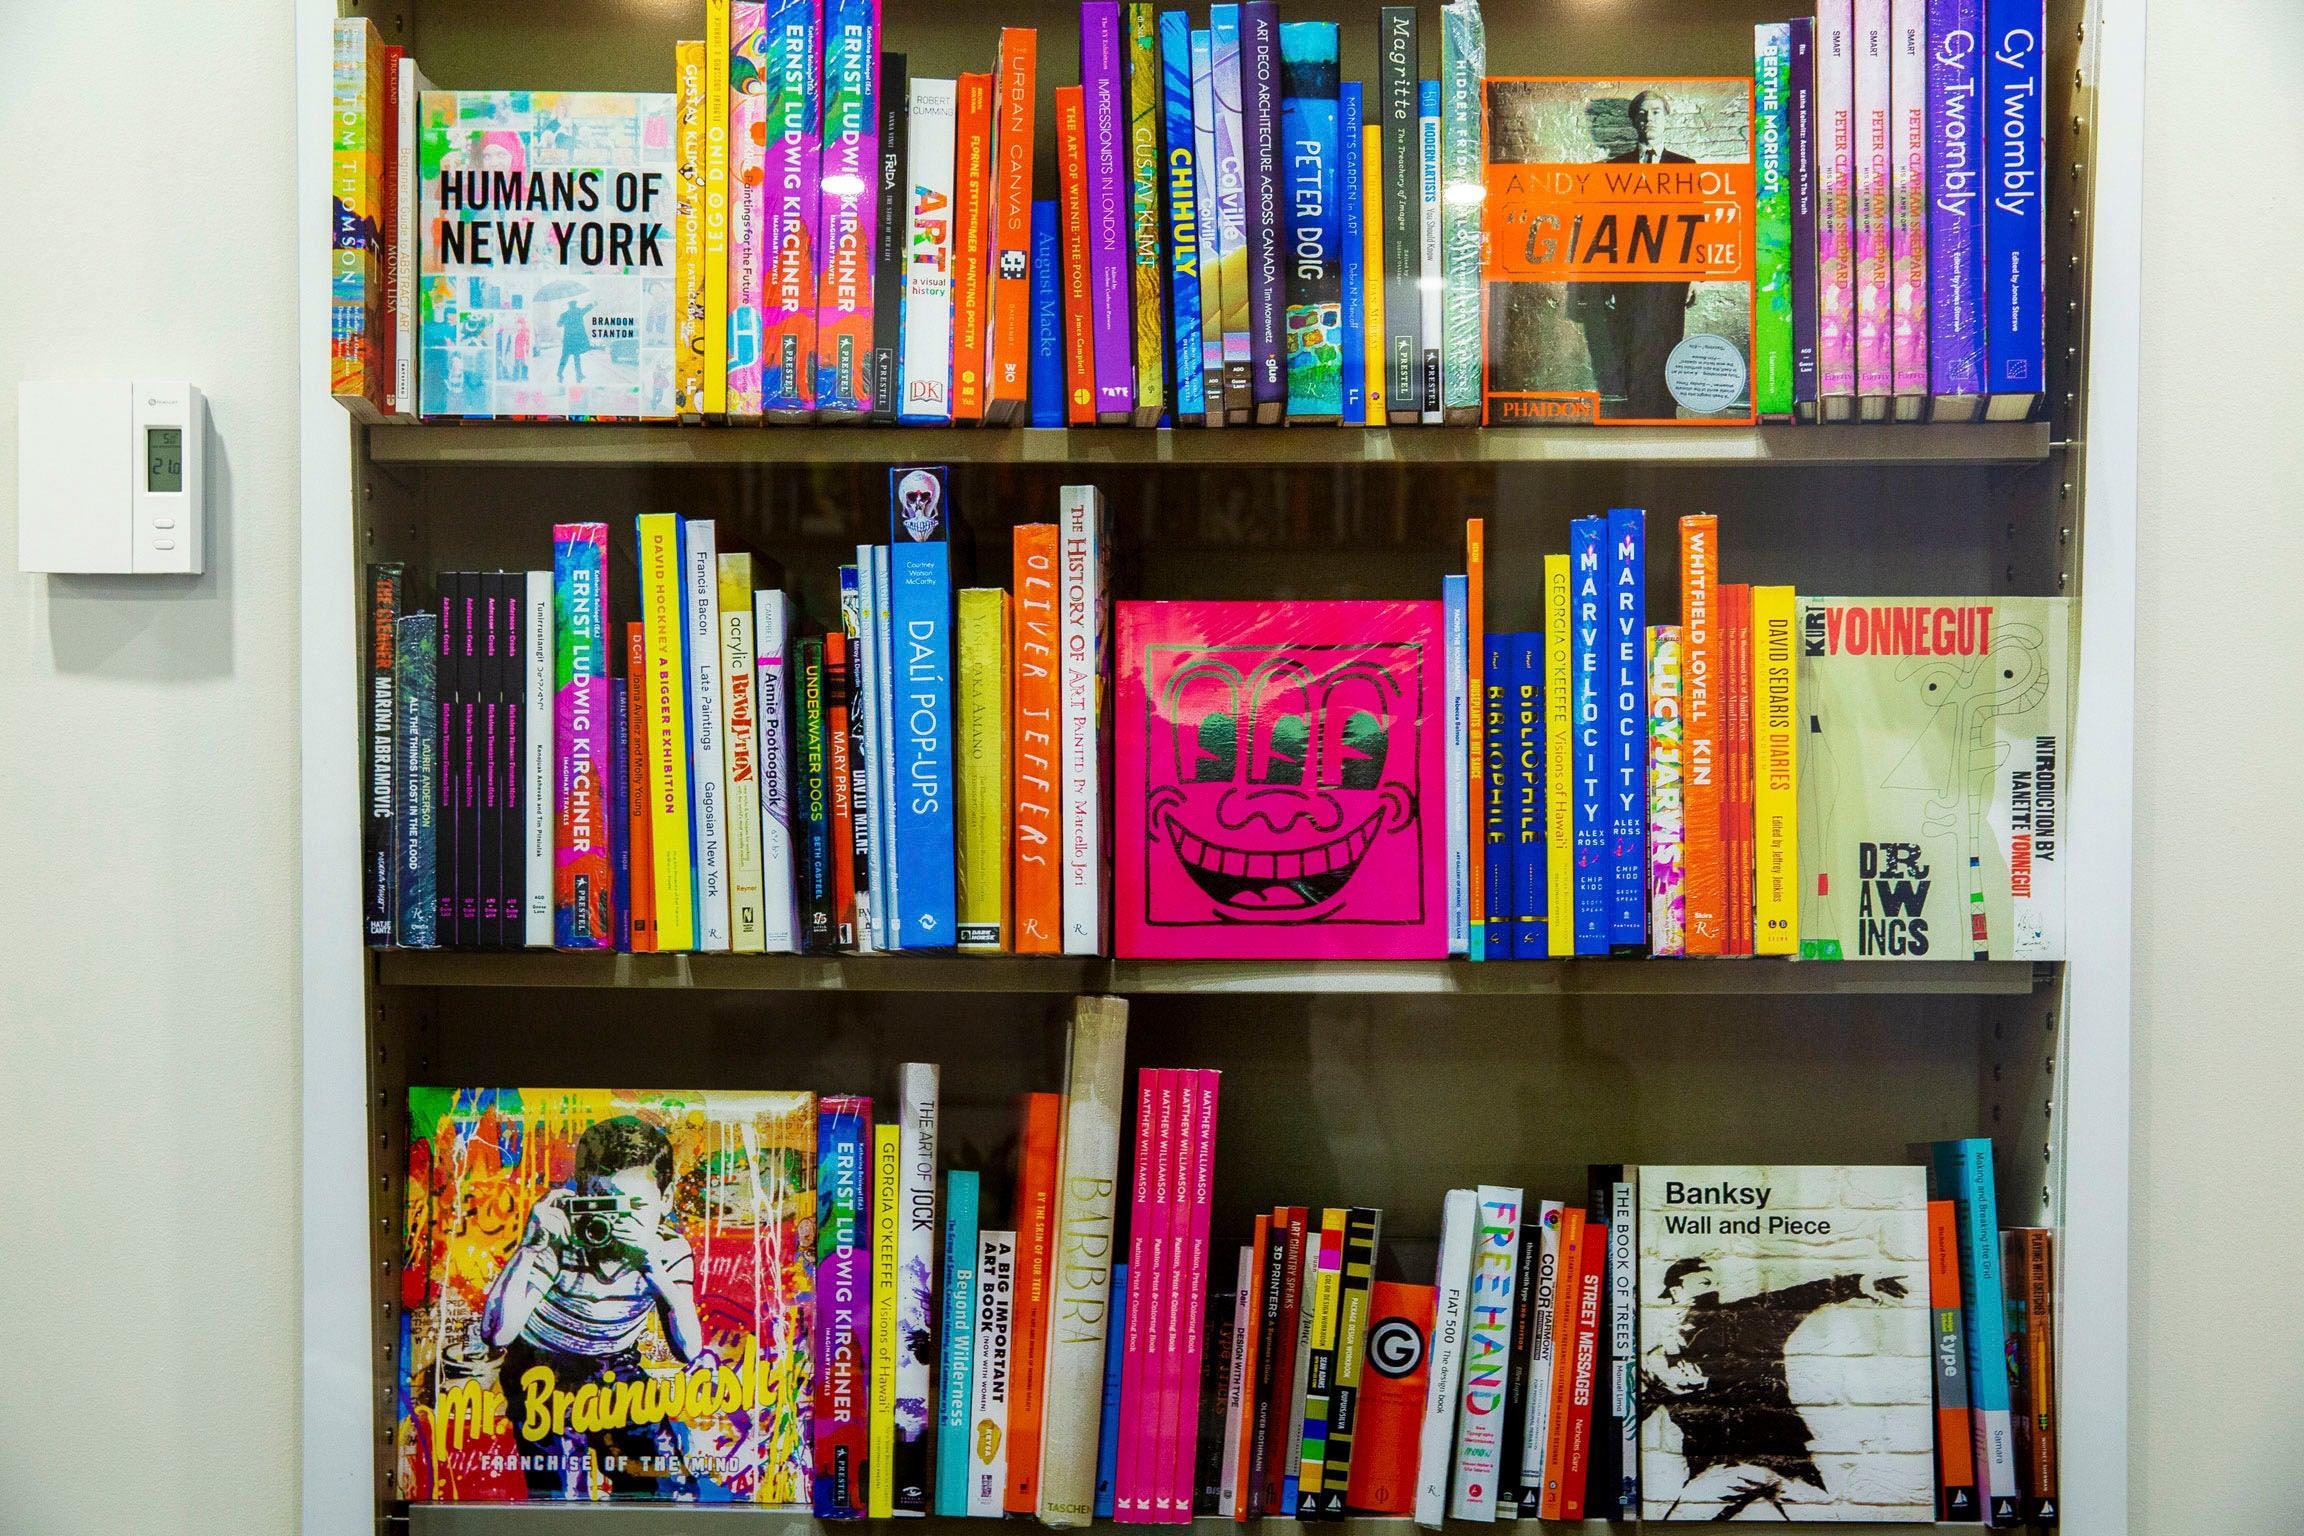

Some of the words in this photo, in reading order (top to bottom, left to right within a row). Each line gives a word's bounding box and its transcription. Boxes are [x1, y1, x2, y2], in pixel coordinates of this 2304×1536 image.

[1257, 19, 1269, 41] ART
[1869, 30, 1878, 57] SMART
[1935, 30, 1974, 70] Cy
[1995, 28, 2034, 69] Cy
[785, 25, 803, 95] ERNST
[1257, 46, 1269, 80] DECO
[1389, 16, 1409, 119] Magritte
[1763, 45, 1778, 110] BERTHE
[1011, 56, 1024, 132] URBAN
[1424, 91, 1435, 106] 50
[342, 97, 356, 146] TOM
[1098, 79, 1113, 174] IMPRESSIONISTS
[1258, 83, 1271, 171] ARCHITECTURE
[1424, 123, 1436, 162] MODERN
[1872, 110, 1884, 149] PETER
[708, 126, 724, 182] DINO
[783, 102, 803, 189] LUDWIG
[1764, 115, 1779, 193] MORISOT
[1937, 77, 1976, 216] Twombly
[1995, 76, 2035, 216] Twombly
[1008, 144, 1023, 230] CANVAS
[1102, 177, 1114, 190] IN
[1295, 140, 1322, 217] PETER
[1396, 146, 1406, 188] Treachery
[1425, 164, 1436, 203] ARTISTS
[1506, 174, 1590, 196] ANDY
[1604, 172, 1736, 196] WARHOL
[440, 171, 600, 212] HUMANS
[616, 173, 662, 212] OF
[742, 176, 753, 226] Paintings
[1260, 175, 1274, 225] ACROSS
[1398, 190, 1407, 200] of
[342, 160, 356, 283] THOMSON
[708, 194, 724, 253] LEGO
[914, 185, 947, 272] ART
[1102, 193, 1115, 250] LONDON
[1171, 148, 1196, 278] CHIHULY
[1397, 200, 1406, 231] Images
[1426, 209, 1434, 220] You
[1426, 221, 1435, 243] Should
[441, 221, 534, 264] NEW
[552, 222, 664, 266] YORK
[743, 228, 752, 245] for
[743, 248, 752, 265] the
[781, 196, 801, 311] KIRCHNER
[1263, 228, 1275, 284] CANADA
[1296, 227, 1323, 280] DOIG
[1426, 244, 1434, 261] Know
[1696, 244, 1736, 264] SIZE
[388, 245, 397, 284] MONA
[1035, 232, 1055, 295] August
[387, 289, 397, 313] LISA
[742, 268, 752, 304] Future
[1264, 288, 1272, 301] Tim
[592, 317, 634, 326] BRANDON
[592, 329, 634, 338] STANTON
[1040, 300, 1055, 357] Macke
[1075, 314, 1084, 336] James
[1264, 303, 1273, 343] Morawetz
[1076, 339, 1085, 374] Campbell
[1503, 402, 1591, 416] PHAIDON
[1071, 505, 1085, 532] THE
[655, 535, 665, 579] DAVID
[375, 579, 393, 605] THE
[1067, 537, 1087, 628] HISTORY
[1690, 532, 1705, 644] WHITFIELD
[656, 585, 667, 652] HOCKNEY
[1023, 555, 1054, 678] OLIVER
[1805, 606, 1826, 656] KURT
[1826, 606, 1994, 656] VONNEGUT
[375, 609, 393, 668] CLEANER
[908, 620, 944, 682] DALÍ
[1069, 635, 1084, 661] OF
[1768, 620, 1789, 662] DAVID
[659, 657, 668, 666] A
[375, 677, 392, 732] MARINA
[410, 696, 418, 714] ALL
[660, 671, 671, 724] BIGGER
[1581, 553, 1598, 822] MARVELOCITY
[1653, 656, 1678, 738] LUCY
[1692, 651, 1706, 722] LOVELL
[1769, 667, 1789, 728] SEDARIS
[410, 716, 418, 734] THE
[806, 665, 820, 772] UNDERWATER
[409, 737, 418, 771] THINGS
[422, 738, 430, 772] LAURIE
[663, 730, 674, 814] EXHIBITION
[910, 694, 937, 815] POP-UPS
[1693, 739, 1711, 785] KIN
[1769, 734, 1790, 790] DIARIES
[374, 736, 394, 818] ABRAMOVIĆ
[409, 780, 418, 802] LOST
[1020, 708, 1049, 865] JEFFERS
[2034, 736, 2056, 838] INTRODUCTION
[409, 805, 418, 816] IN
[422, 775, 430, 828] ANDERSON
[810, 778, 823, 821] DOGS
[2012, 771, 2032, 830] NANETTE
[409, 819, 418, 836] THE
[409, 839, 418, 869] FLOOD
[2010, 833, 2031, 899] VONNEGUT
[2034, 840, 2054, 862] BY
[919, 1100, 935, 1128] THE
[1141, 1088, 1151, 1137] MATTHEW
[918, 1131, 933, 1159] ART
[917, 1162, 932, 1181] OF
[1137, 1139, 1148, 1203] WILLIAMSON
[1975, 1152, 1986, 1183] Making
[910, 1187, 934, 1232] JOCK
[1617, 1188, 1629, 1217] THE
[1664, 1181, 1772, 1209] Banksy
[1977, 1186, 1987, 1202] and
[1664, 1216, 1712, 1234] Wall
[1718, 1216, 1760, 1234] and
[1768, 1216, 1832, 1234] Piece
[1978, 1204, 1989, 1241] Breaking
[999, 1243, 1011, 1255] A
[1064, 1176, 1113, 1344] BARBRA
[1192, 1239, 1202, 1270] Fashion,
[1617, 1224, 1629, 1269] BOOK
[1982, 1244, 1990, 1258] the
[997, 1263, 1010, 1298] BIG
[1538, 1253, 1554, 1309] COLOR
[1617, 1276, 1629, 1296] OF
[1982, 1261, 1992, 1280] Grid
[955, 1269, 973, 1329] Beyond
[1188, 1301, 1197, 1333] Coloring
[1465, 1201, 1516, 1416] FREEHAND
[1188, 1335, 1196, 1353] Book
[1235, 1327, 1245, 1361] DESIGN
[1542, 1310, 1553, 1361] HARMONY
[1617, 1303, 1629, 1349] TREES
[992, 1300, 1008, 1403] IMPORTANT
[1940, 1335, 1958, 1377] type
[951, 1336, 970, 1426] Wilderness
[1233, 1362, 1243, 1385] WITH
[1616, 1365, 1624, 1392] Manuel
[434, 1379, 506, 1464] Mr.
[520, 1333, 784, 1442] Brainwash
[1231, 1385, 1241, 1408] TYPE
[480, 1455, 592, 1472] FRANCHISE
[605, 1455, 628, 1472] OF
[640, 1455, 680, 1472] THE
[692, 1455, 740, 1472] MIND
[1994, 1430, 2004, 1464] Samara
